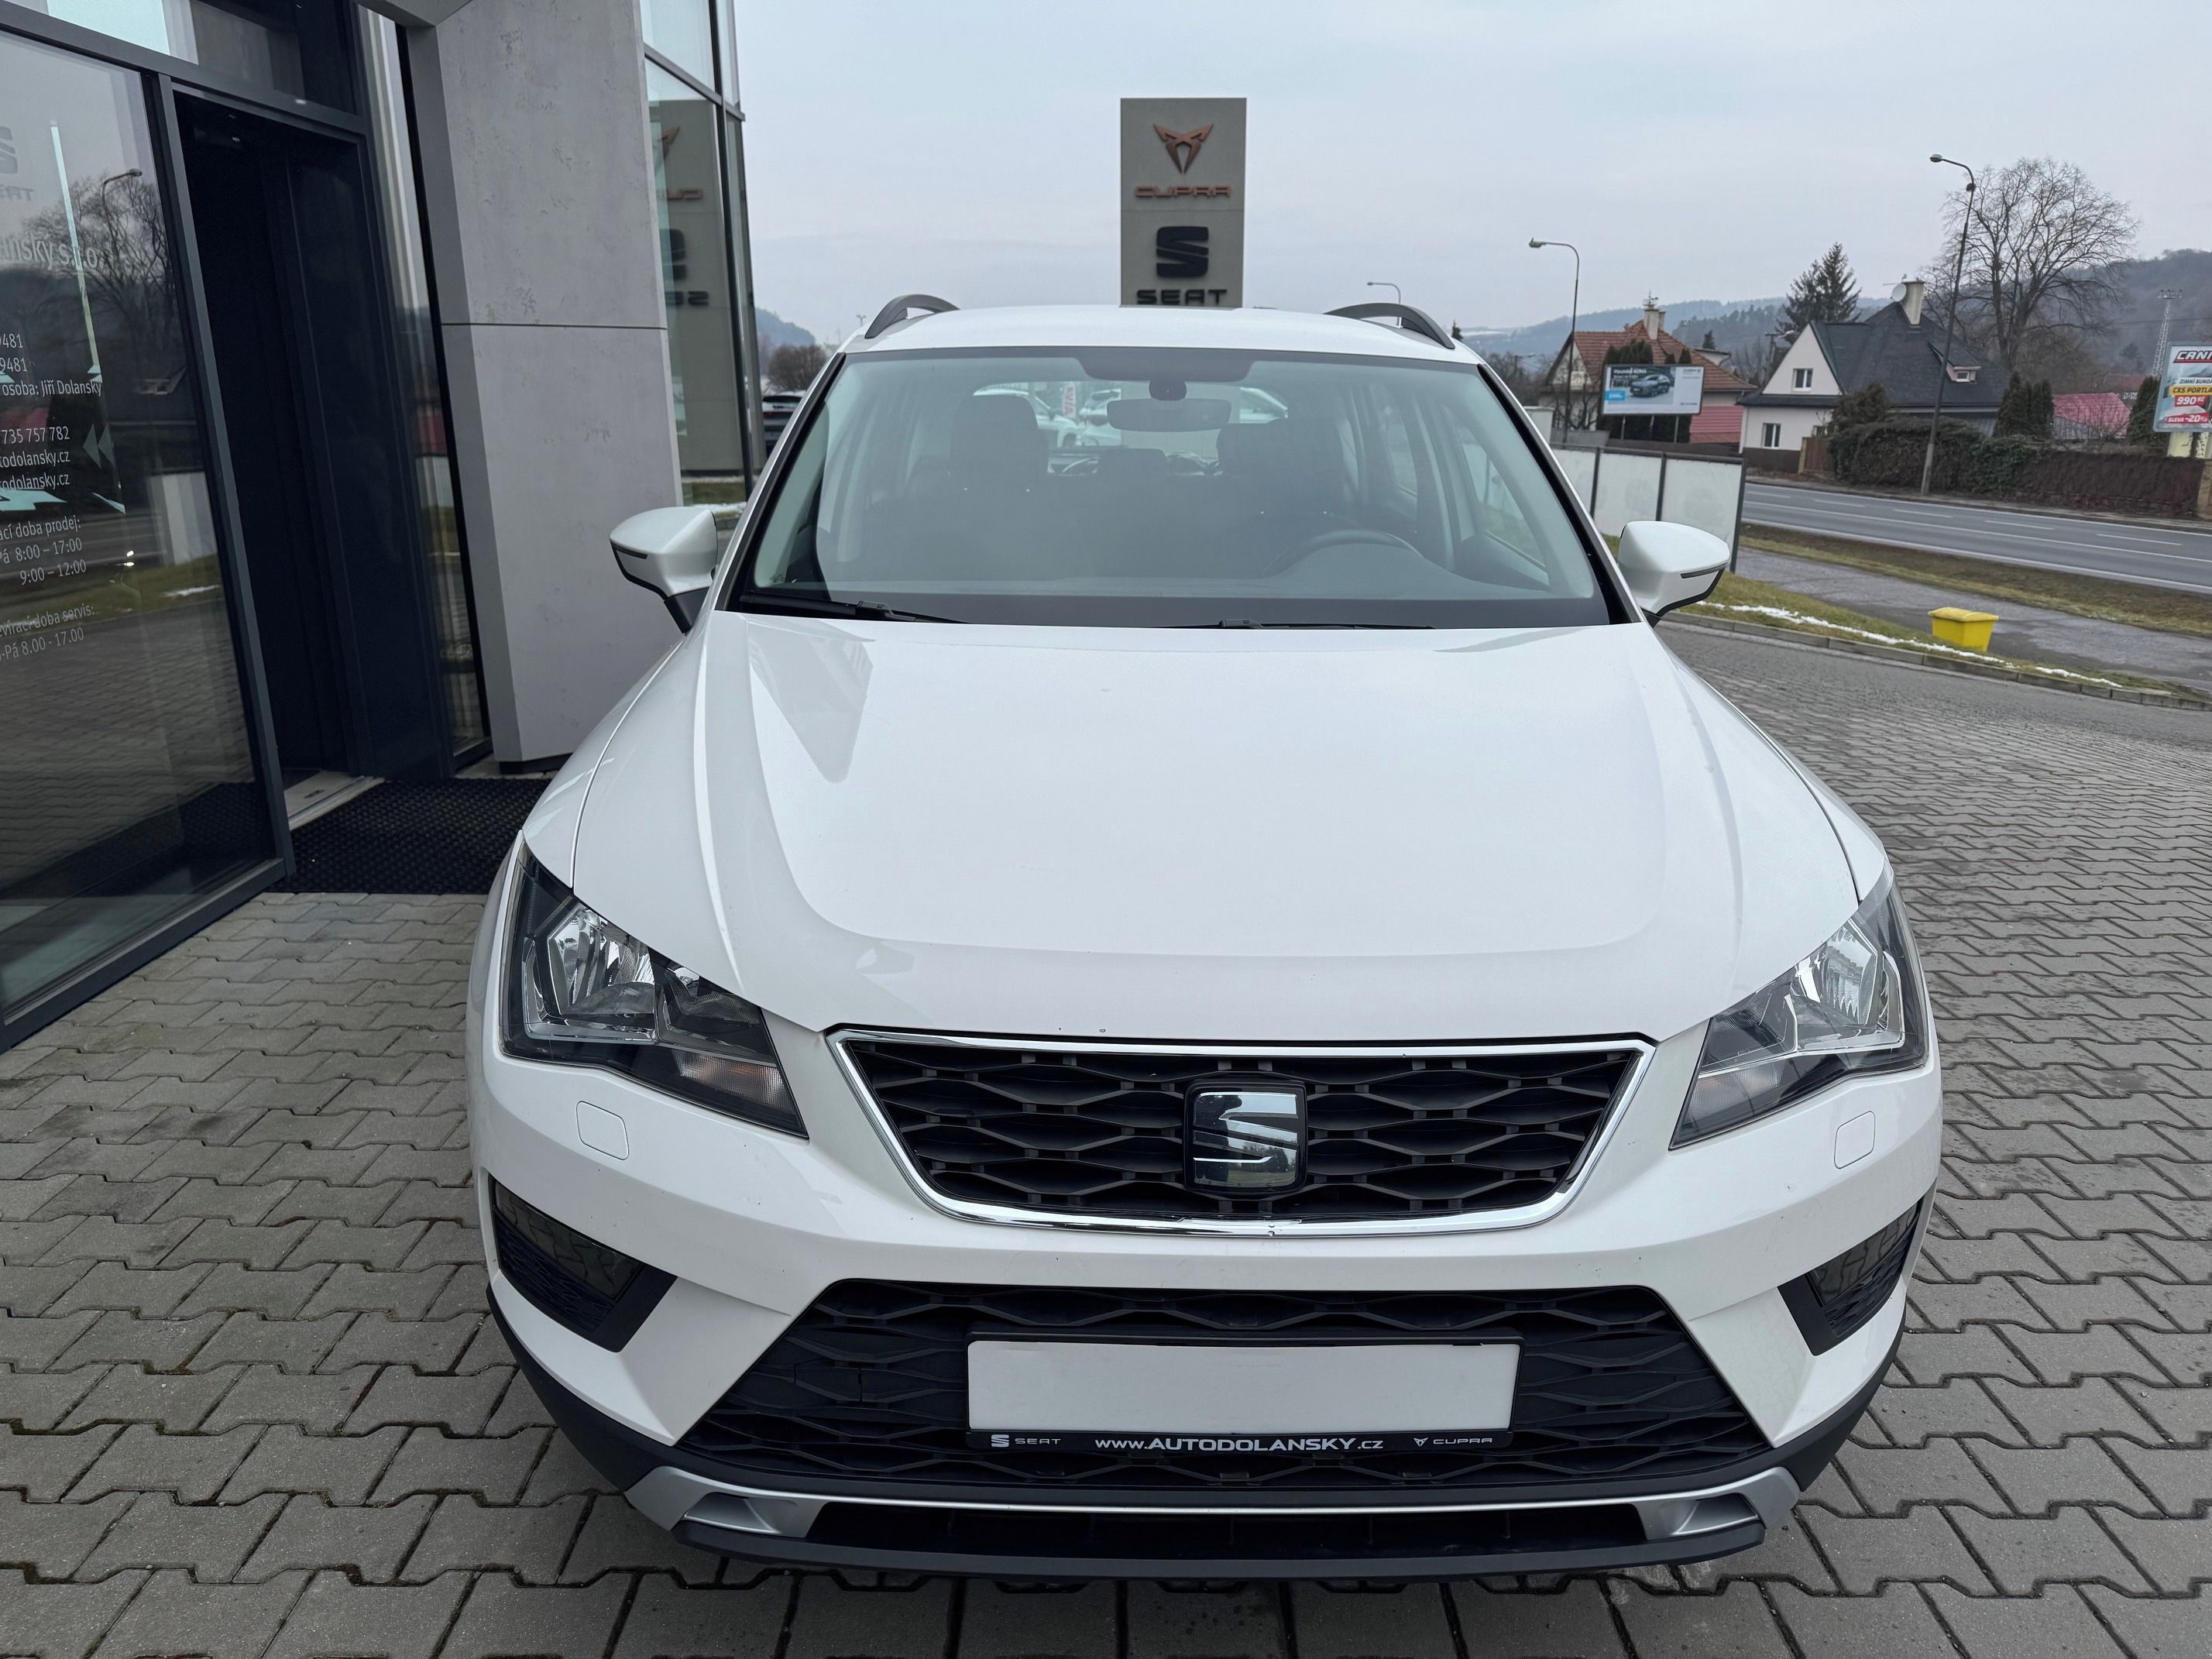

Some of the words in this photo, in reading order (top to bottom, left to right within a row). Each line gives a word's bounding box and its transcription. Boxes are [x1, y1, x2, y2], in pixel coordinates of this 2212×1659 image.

[1135, 186, 1233, 198] CUPRA
[1136, 289, 1228, 305] SEAT
[0, 333, 23, 349] 481
[2, 380, 40, 397] osoba:
[41, 380, 56, 397] Jiří
[2176, 397, 2197, 405] 990
[2, 428, 24, 445] 735
[26, 427, 46, 443] 757
[49, 425, 70, 441] 782
[15, 520, 43, 538] doba
[45, 514, 81, 537] prodej:
[15, 544, 40, 562] 8:00
[52, 538, 82, 555] 17:00
[19, 566, 45, 586] 9:00
[57, 558, 87, 577] 12:00
[35, 610, 60, 629] doba
[62, 603, 95, 622] servis:
[21, 636, 46, 655] 8.00
[54, 627, 84, 646] 17.00
[1094, 1437, 1384, 1451] www.AUTODOLANSKY.cz
